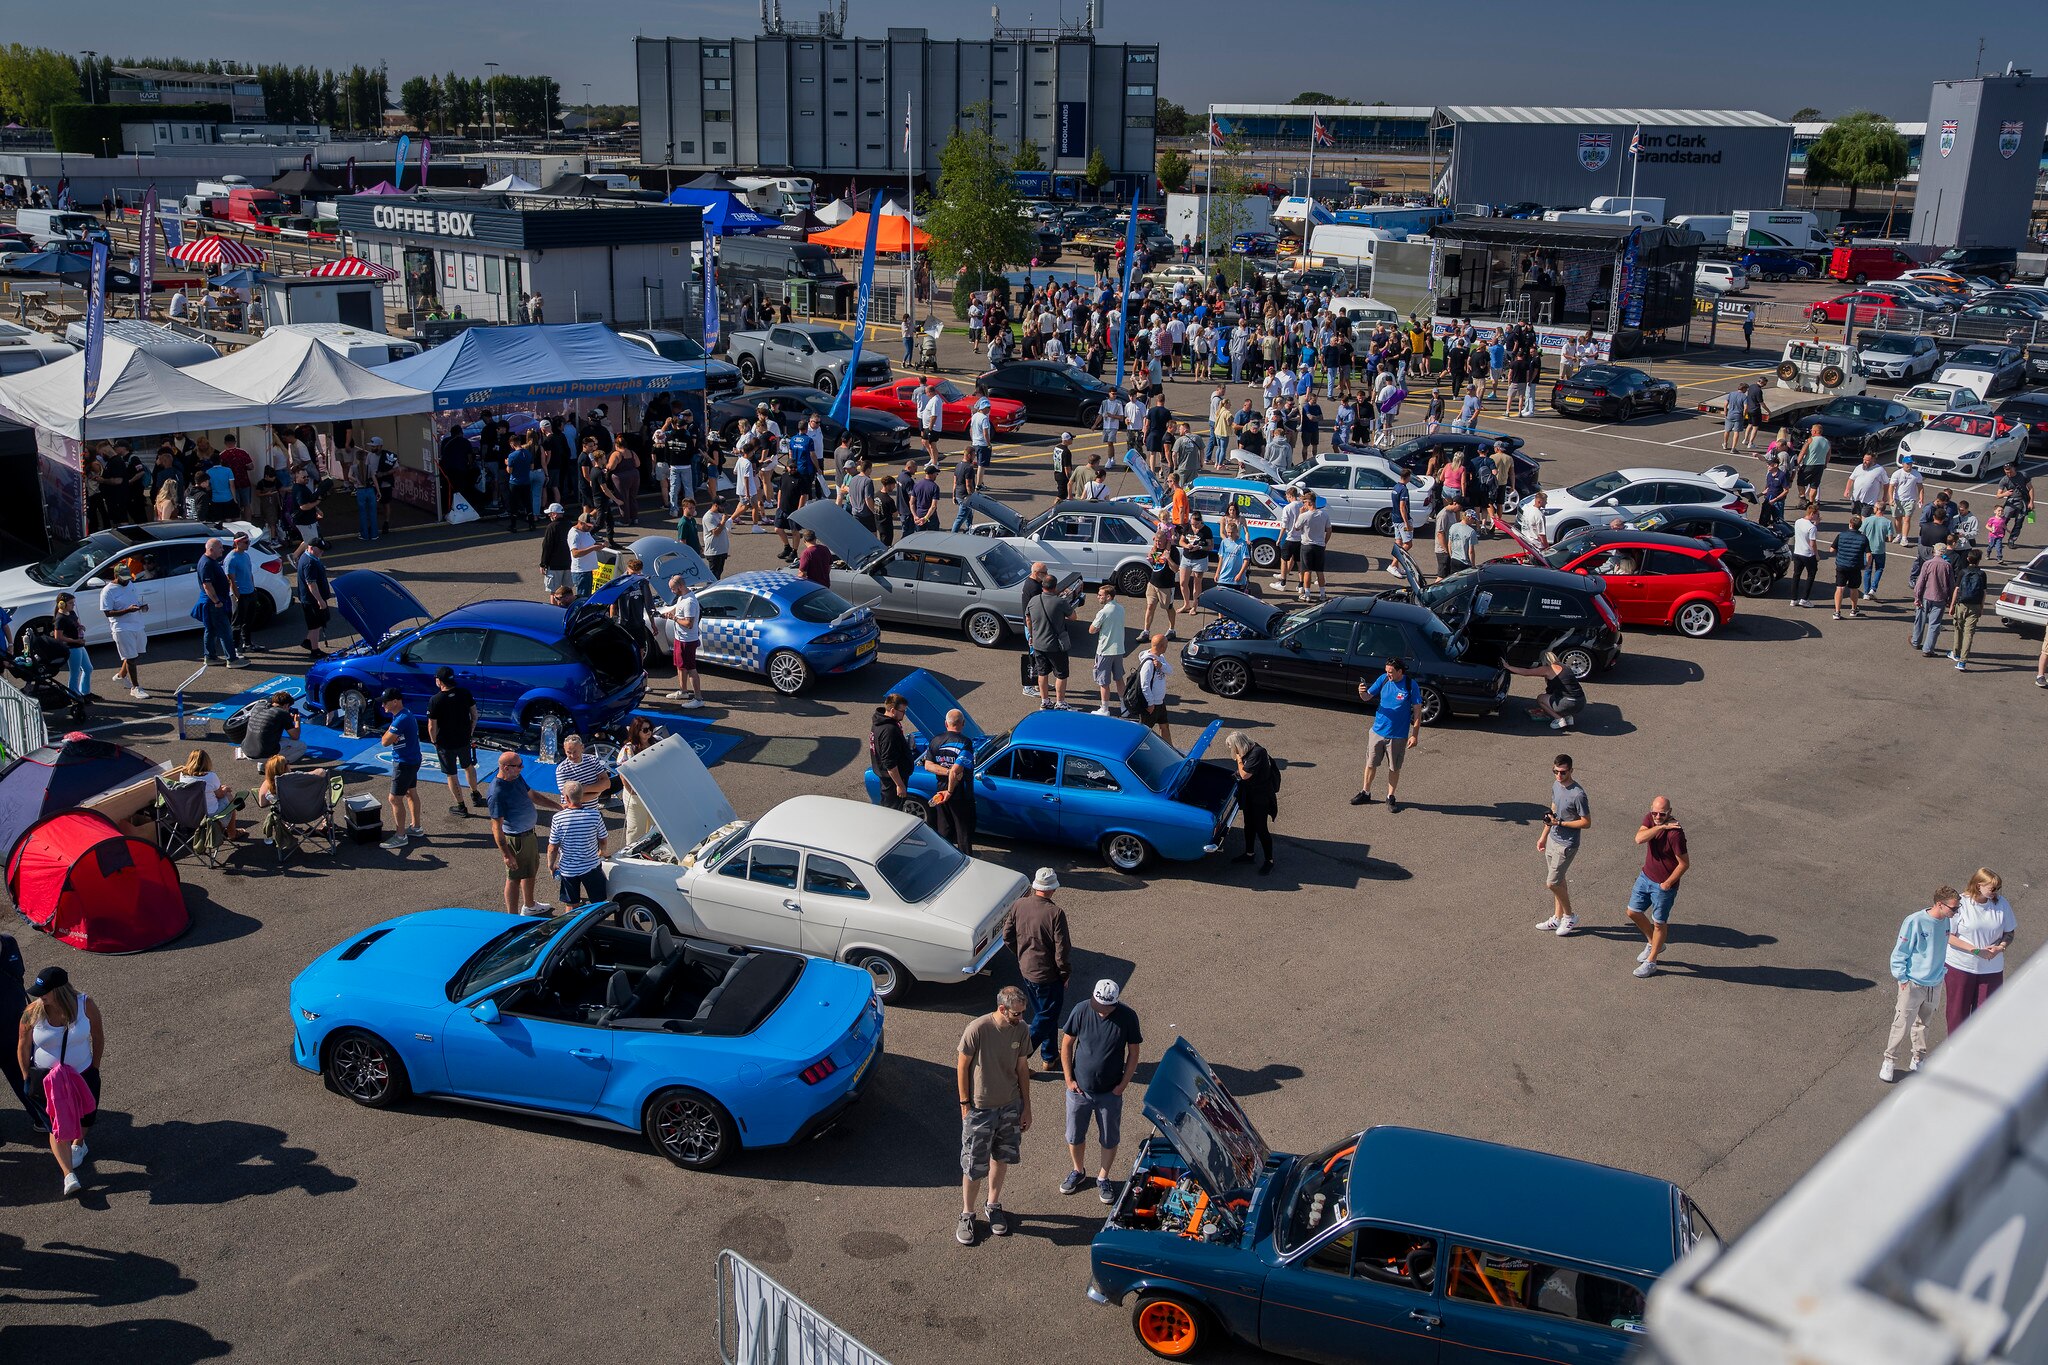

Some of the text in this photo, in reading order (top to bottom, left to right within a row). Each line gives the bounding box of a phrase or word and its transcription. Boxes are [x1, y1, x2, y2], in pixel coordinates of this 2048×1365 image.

[1061, 104, 1069, 154] BROOKLANDS
[1665, 134, 1707, 147] Clark
[373, 205, 475, 237] COFFEE BOX
[143, 241, 151, 277] DRINK
[527, 383, 567, 396] Arrival
[571, 378, 643, 393] Photographs
[1237, 494, 1251, 507] 88
[1247, 519, 1269, 527] KENT
